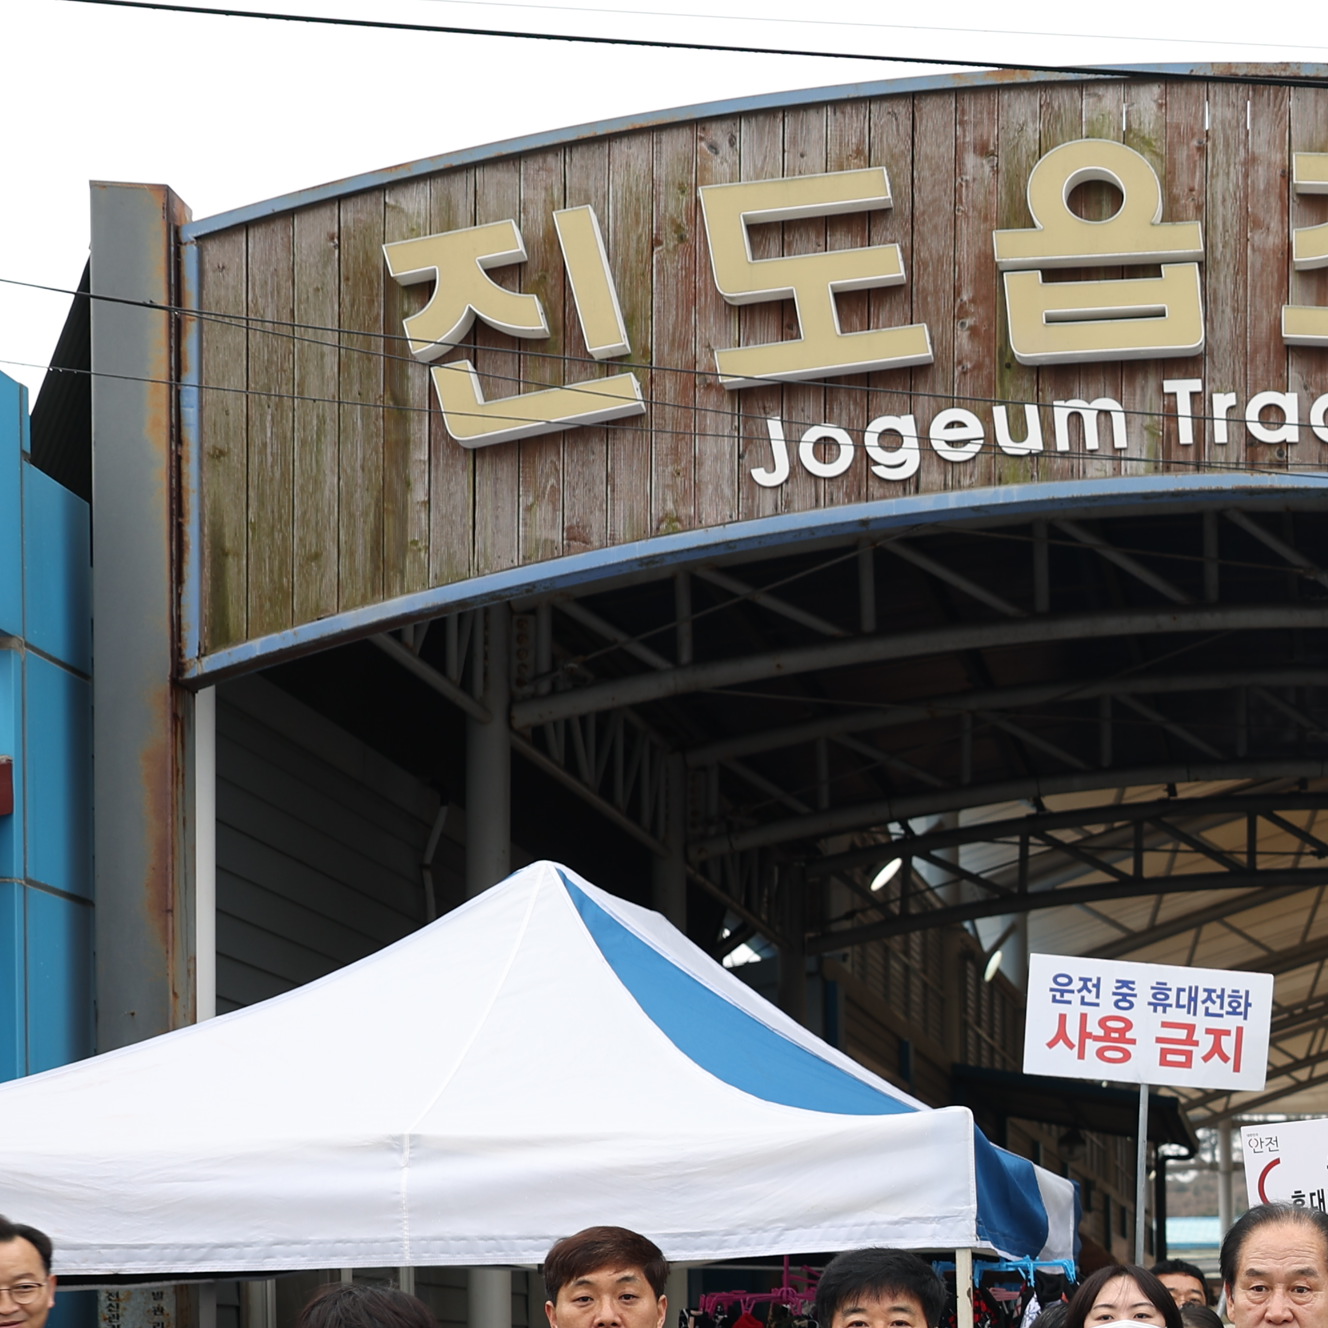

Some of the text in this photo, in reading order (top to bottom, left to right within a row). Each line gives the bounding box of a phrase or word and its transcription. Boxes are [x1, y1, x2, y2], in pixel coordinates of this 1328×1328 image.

[750, 398, 1128, 490] Jogeum
[1048, 972, 1252, 1021] 운전 중 휴대전화
[1046, 1012, 1244, 1073] 사용 금지
[1248, 1136, 1279, 1154] 안전
